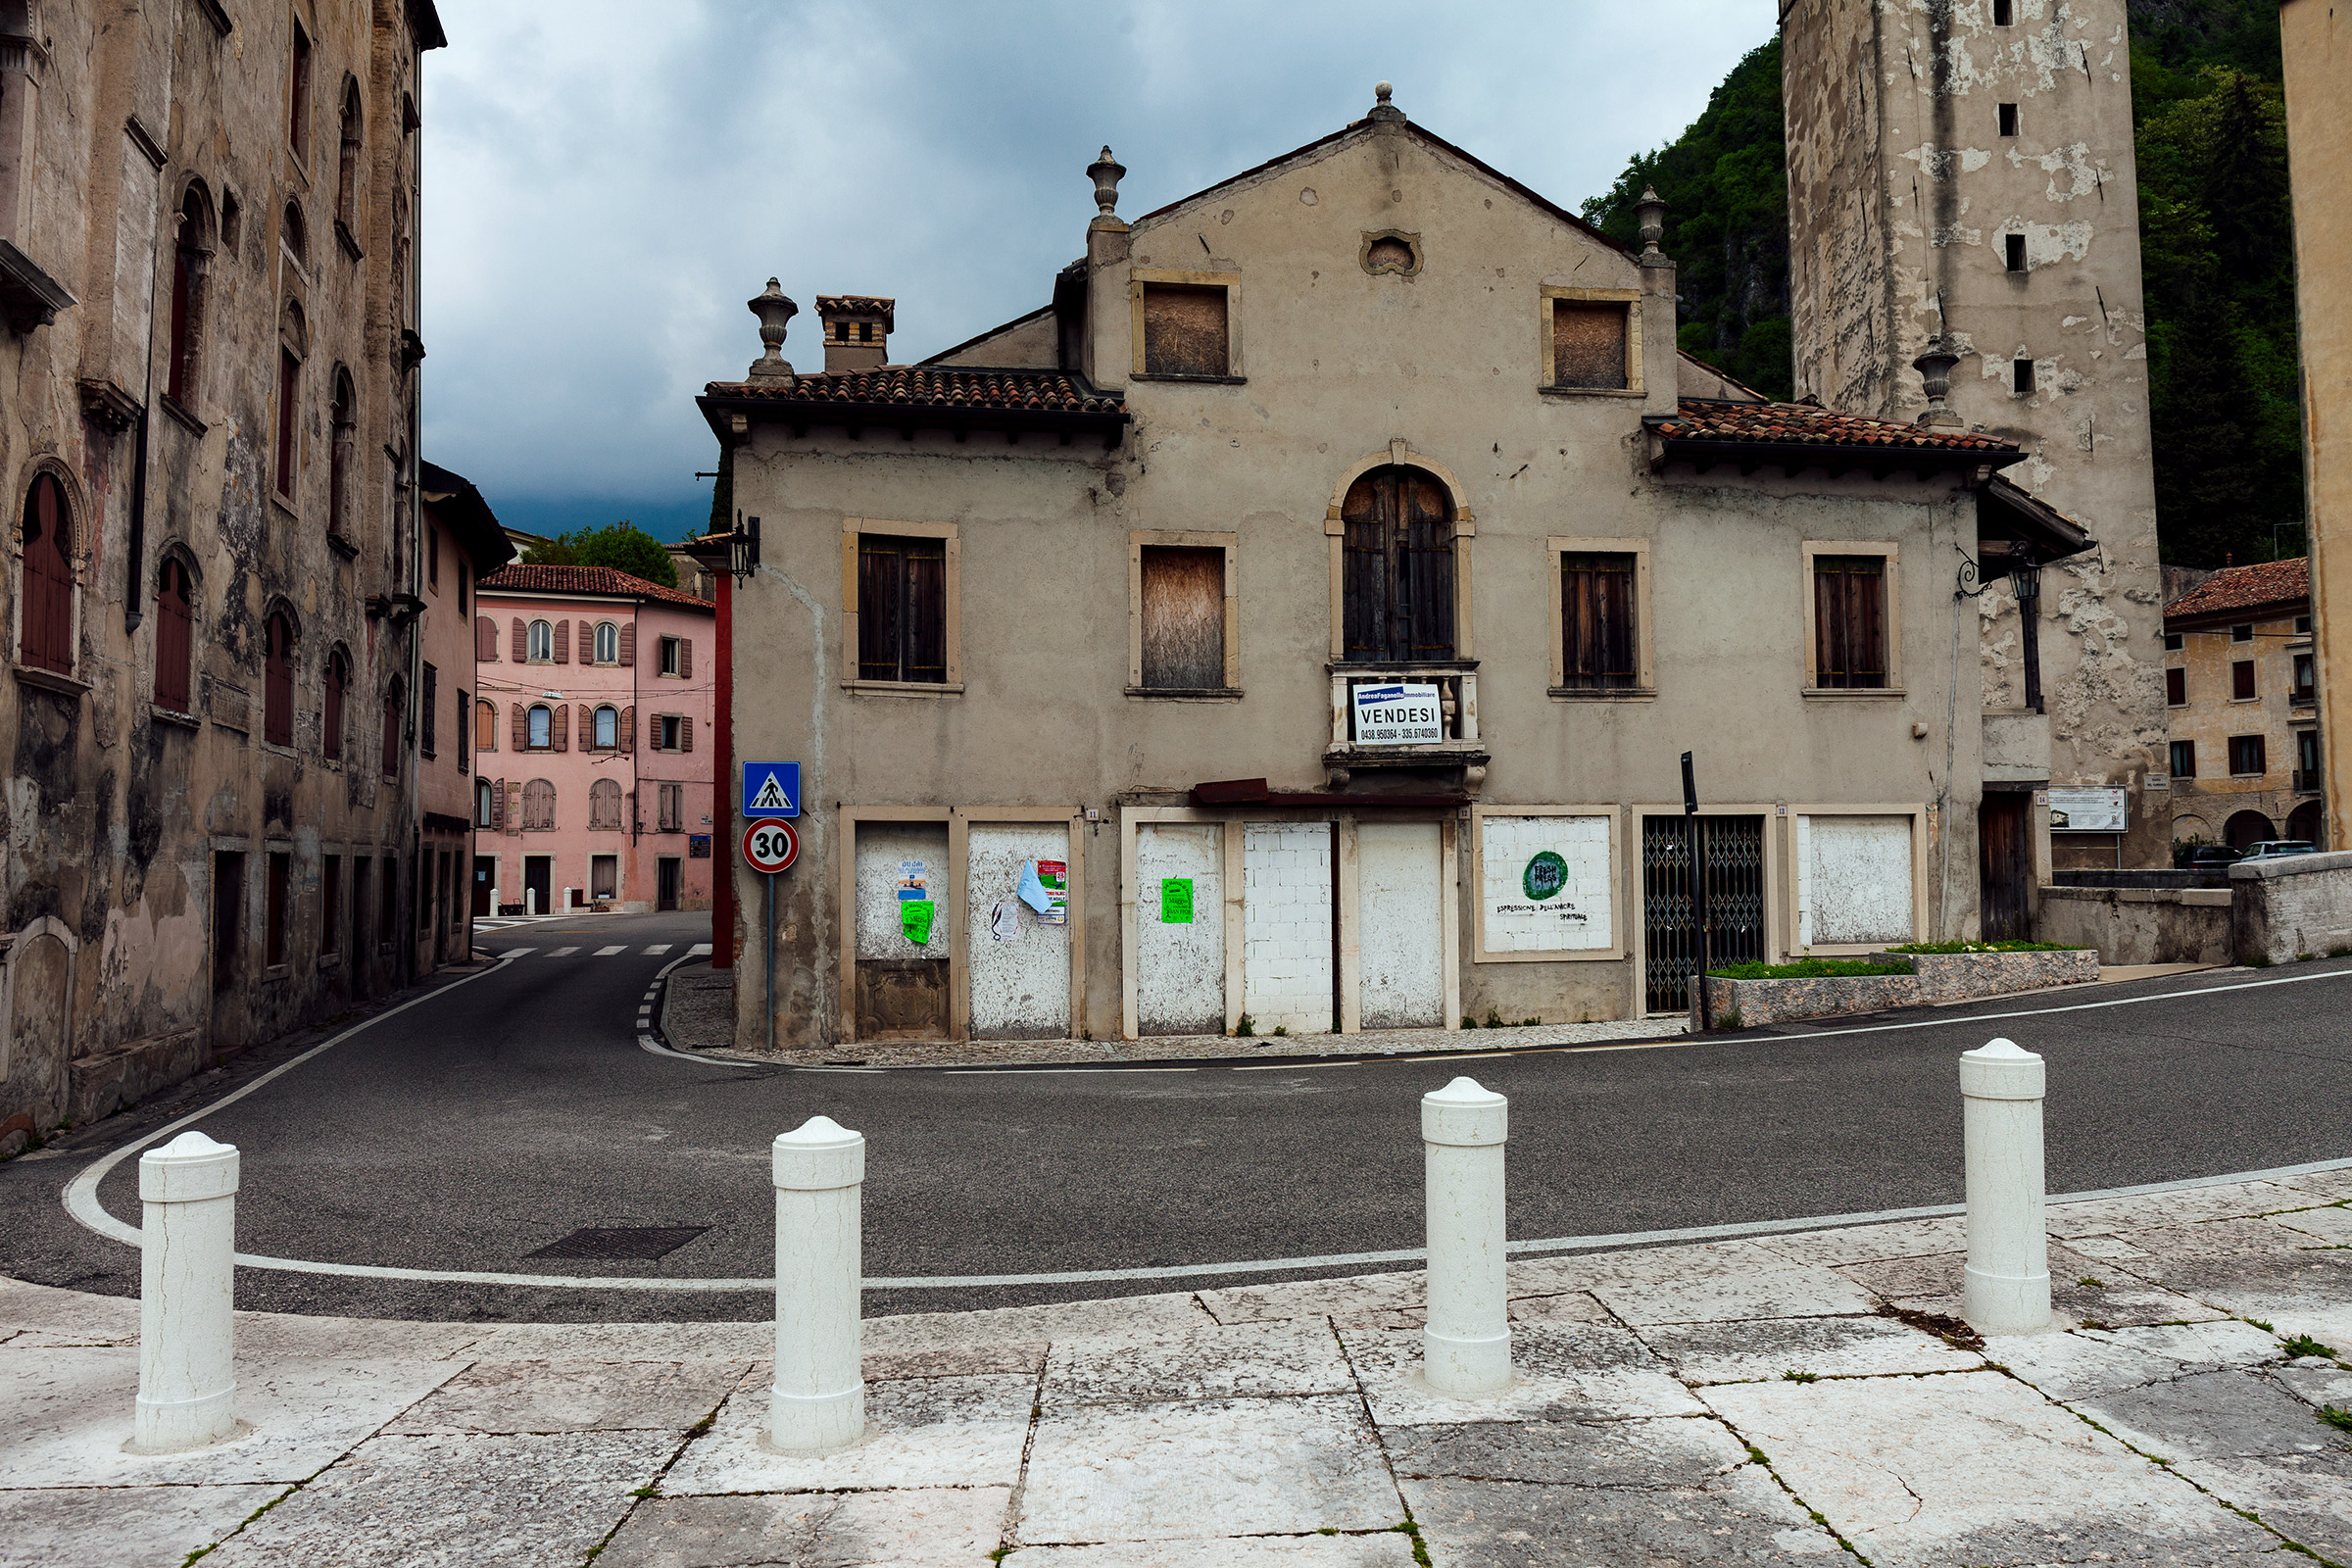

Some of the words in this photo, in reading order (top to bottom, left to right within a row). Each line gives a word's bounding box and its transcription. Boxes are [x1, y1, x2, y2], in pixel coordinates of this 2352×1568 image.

[1360, 708, 1435, 723] VENDESI
[755, 832, 789, 858] 30
[1534, 865, 1556, 874] FRESH
[1534, 873, 1557, 883] PRESS
[1496, 905, 1536, 913] ESPRESSIONE
